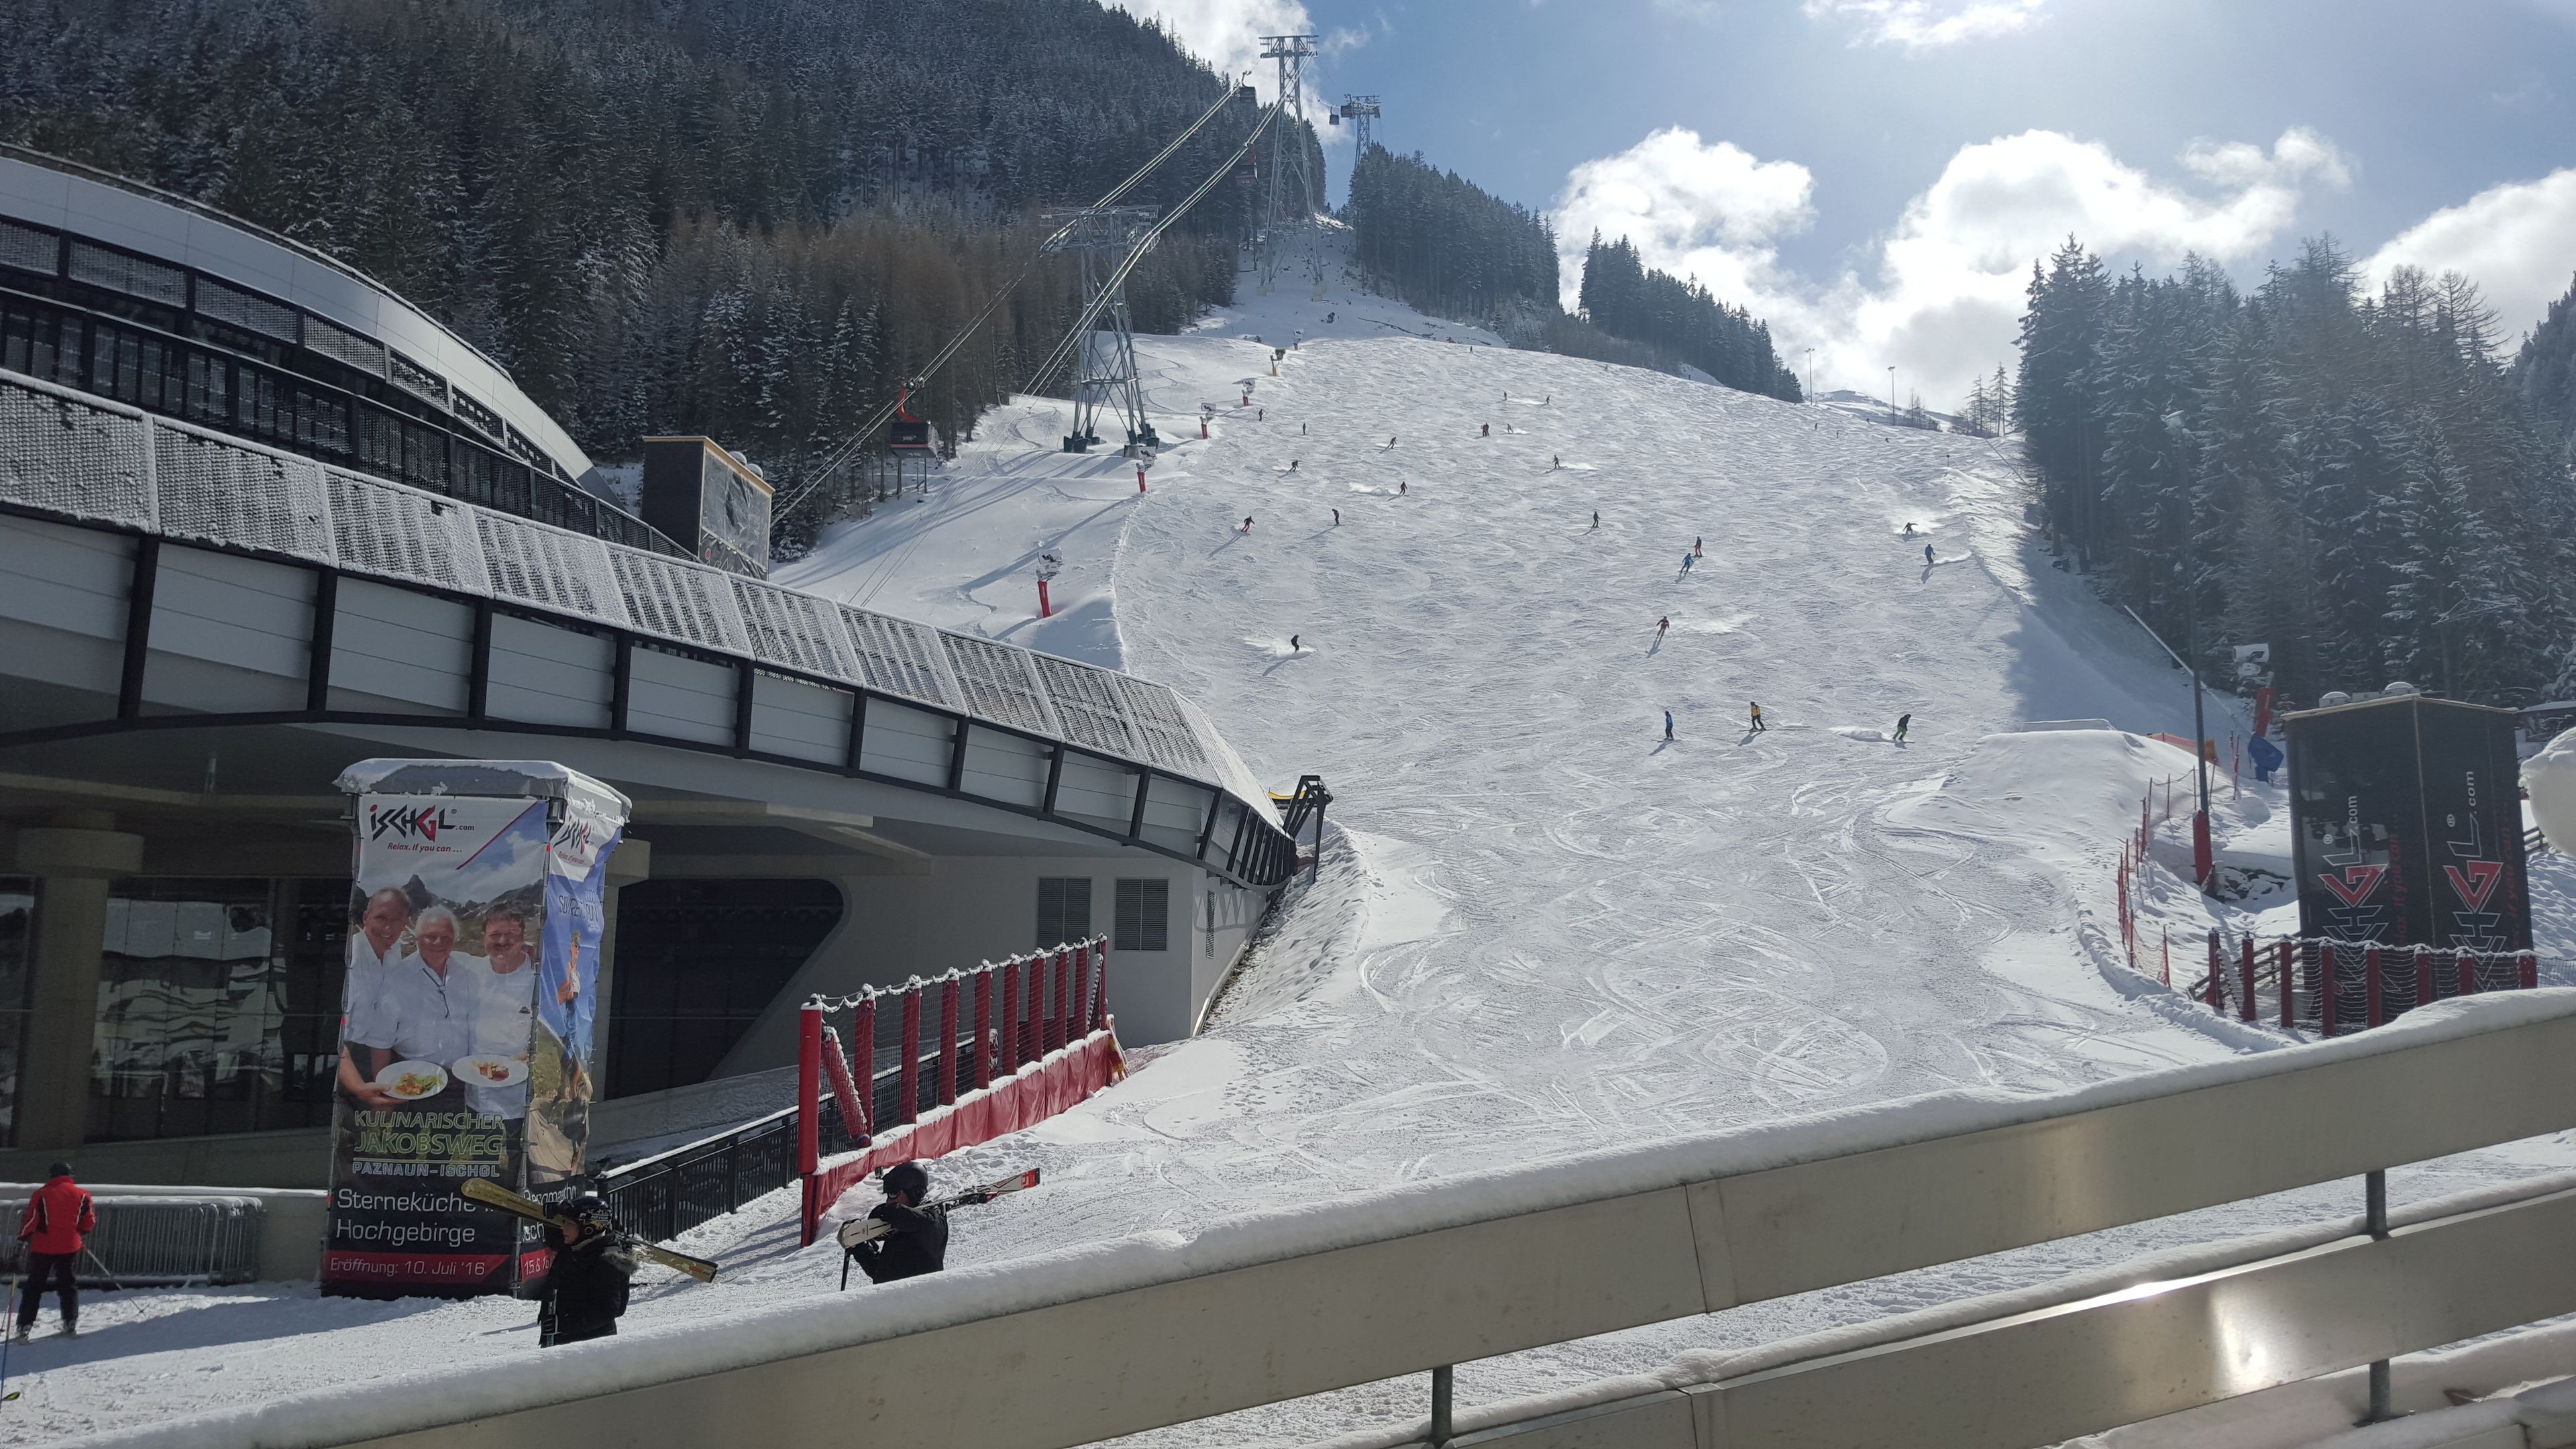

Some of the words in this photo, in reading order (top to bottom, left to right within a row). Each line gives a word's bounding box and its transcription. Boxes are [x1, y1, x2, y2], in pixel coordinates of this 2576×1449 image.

[2467, 771, 2478, 814] .com
[388, 843, 411, 851] Relax.
[412, 843, 419, 851] If
[354, 1110, 504, 1130] KULINARISCHER
[354, 1132, 504, 1155] JAKOBSWEG
[352, 1162, 500, 1177] PAZNAUN-ISCHGL
[337, 1188, 477, 1212] Sterneküche
[336, 1218, 476, 1247] Hochgebirge
[330, 1257, 398, 1277] Eröffnung:
[405, 1260, 427, 1275] 10.
[432, 1262, 457, 1275] Juli
